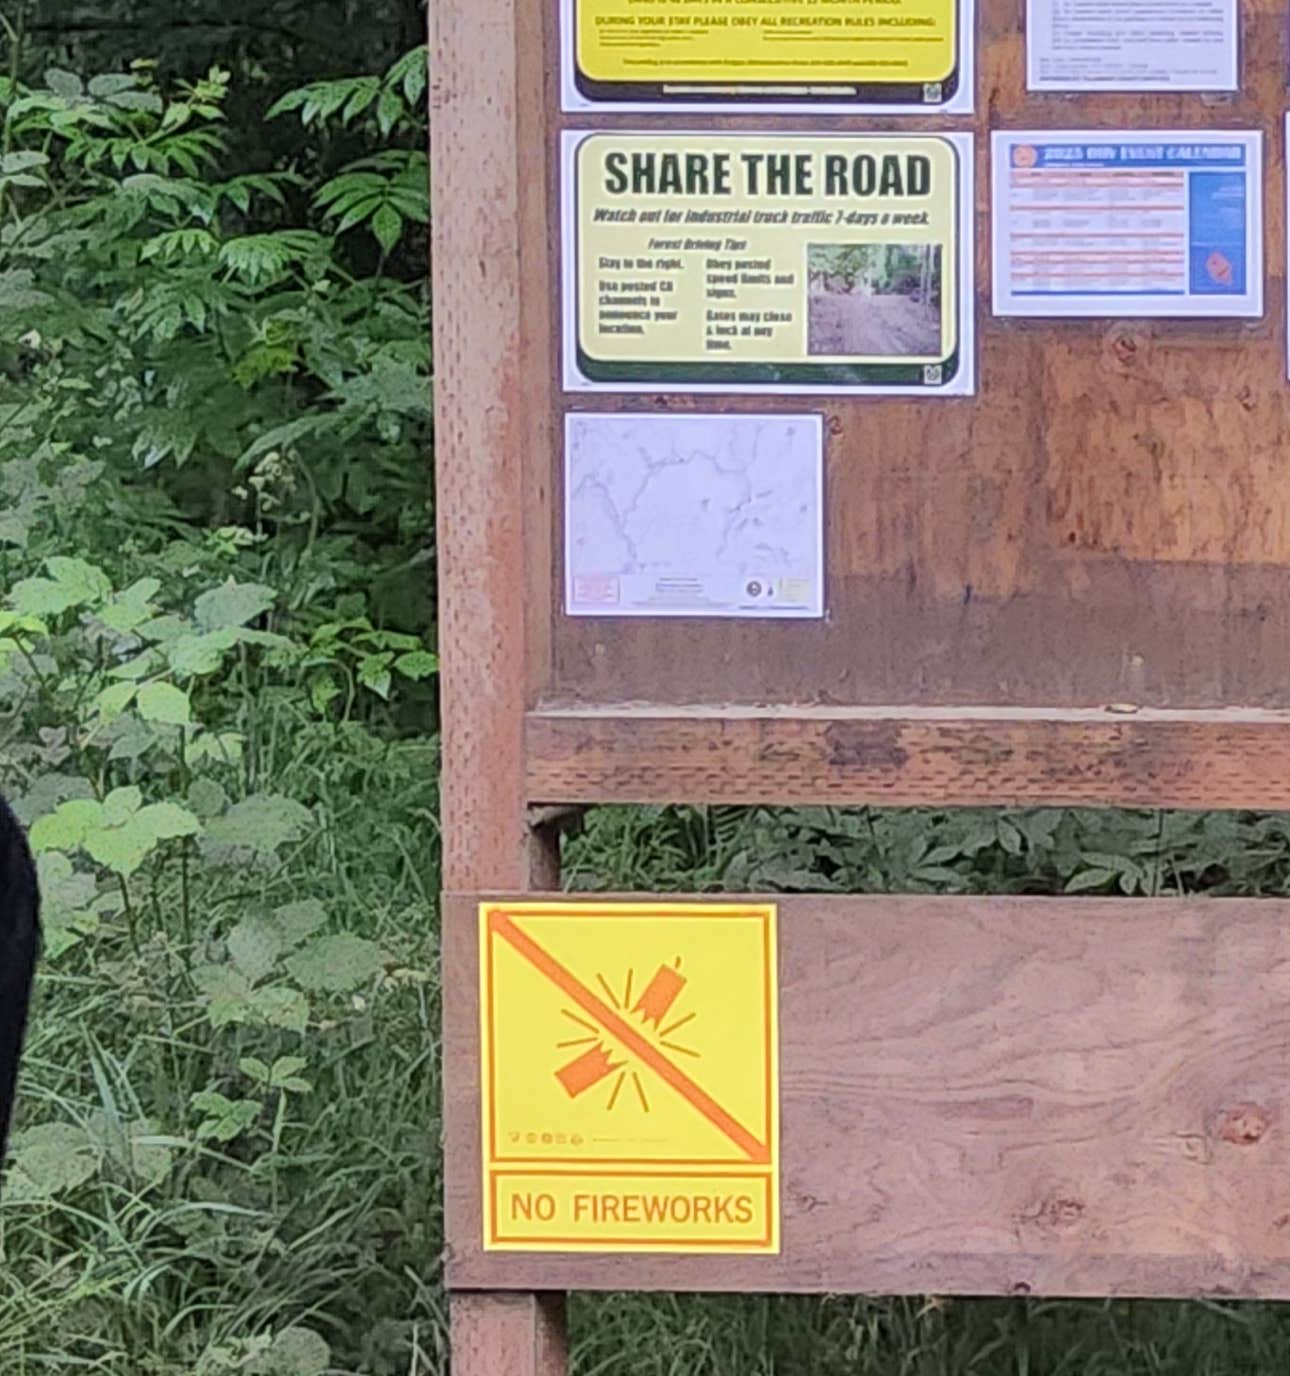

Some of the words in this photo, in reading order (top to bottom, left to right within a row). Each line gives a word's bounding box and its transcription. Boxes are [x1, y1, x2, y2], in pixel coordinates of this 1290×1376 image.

[604, 152, 731, 196] SHARE
[741, 153, 812, 196] THE
[825, 154, 931, 196] ROAD
[593, 208, 637, 222] Watch
[639, 209, 660, 223] out
[663, 209, 683, 223] for
[685, 209, 751, 223] industrial
[754, 210, 788, 224] truck
[790, 210, 831, 224] traffic
[510, 1193, 557, 1222] NO
[573, 1194, 753, 1224] FIREWORKS
